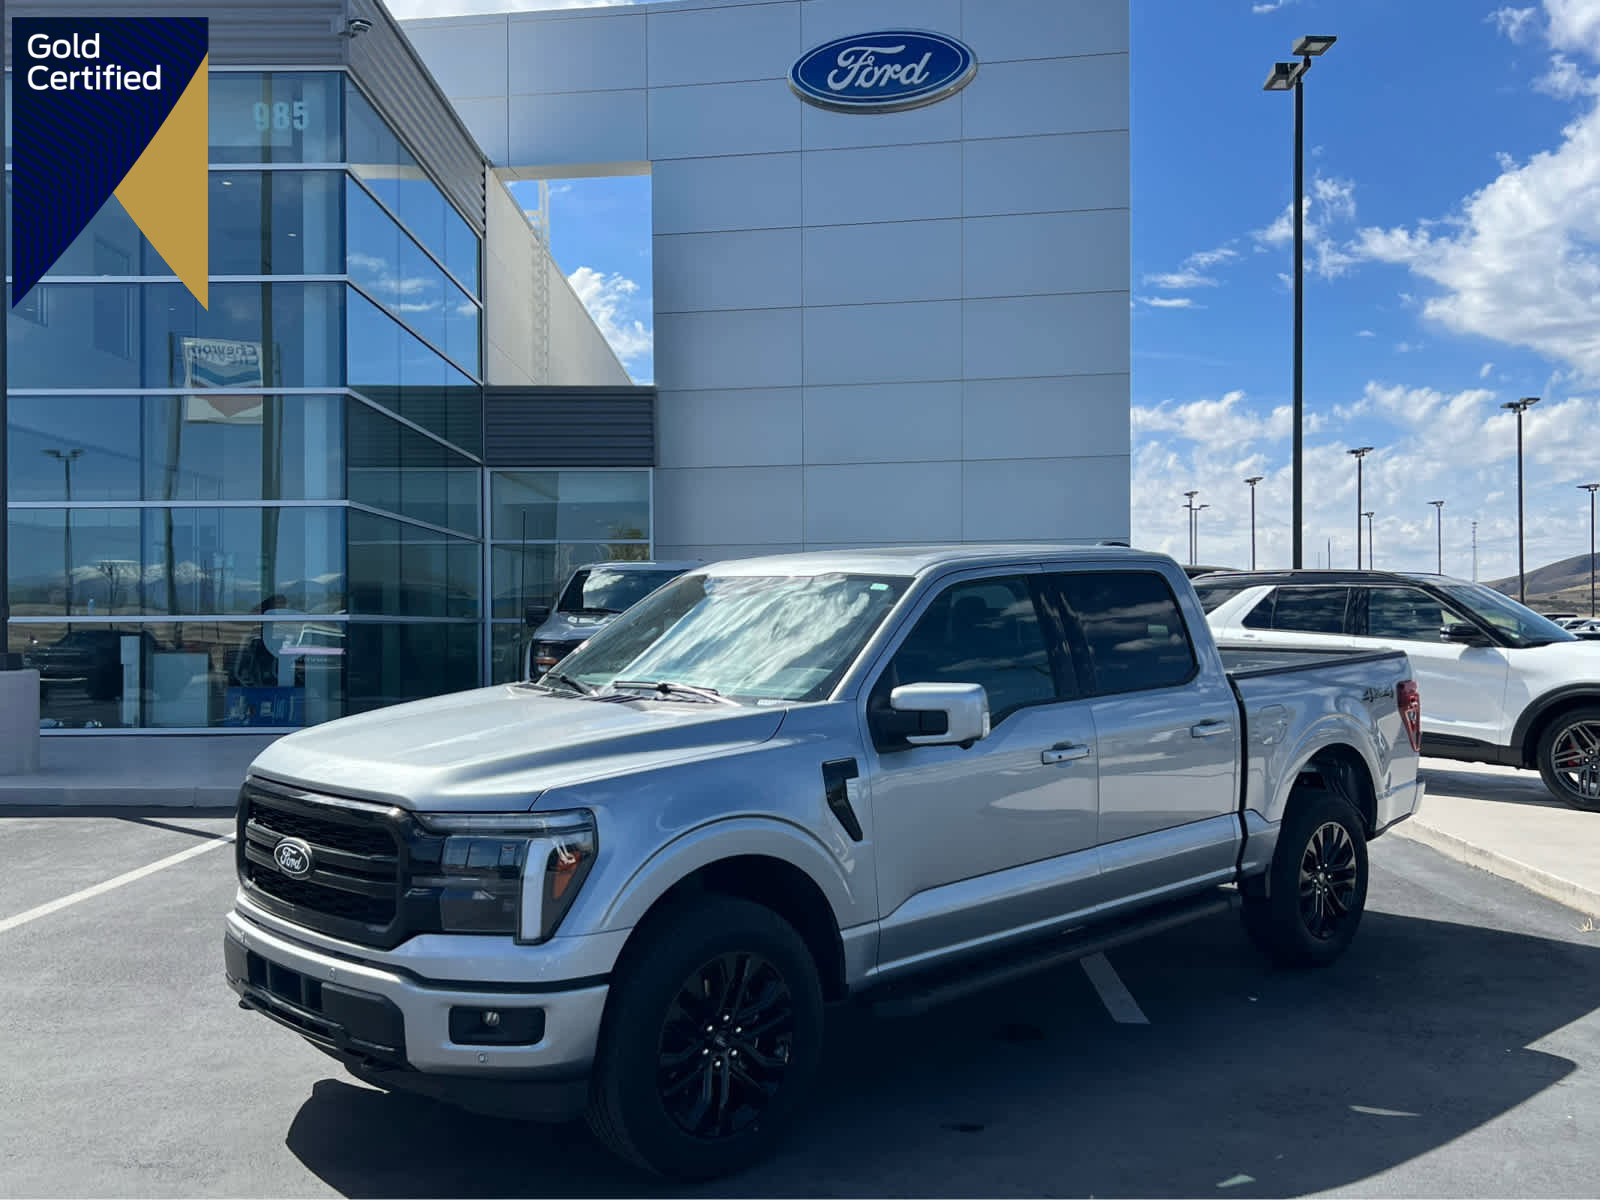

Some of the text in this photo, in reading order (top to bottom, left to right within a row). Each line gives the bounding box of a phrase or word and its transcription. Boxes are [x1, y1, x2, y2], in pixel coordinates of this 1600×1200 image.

[827, 45, 932, 90] Ford
[254, 101, 309, 131] 985
[280, 846, 302, 870] Ford
